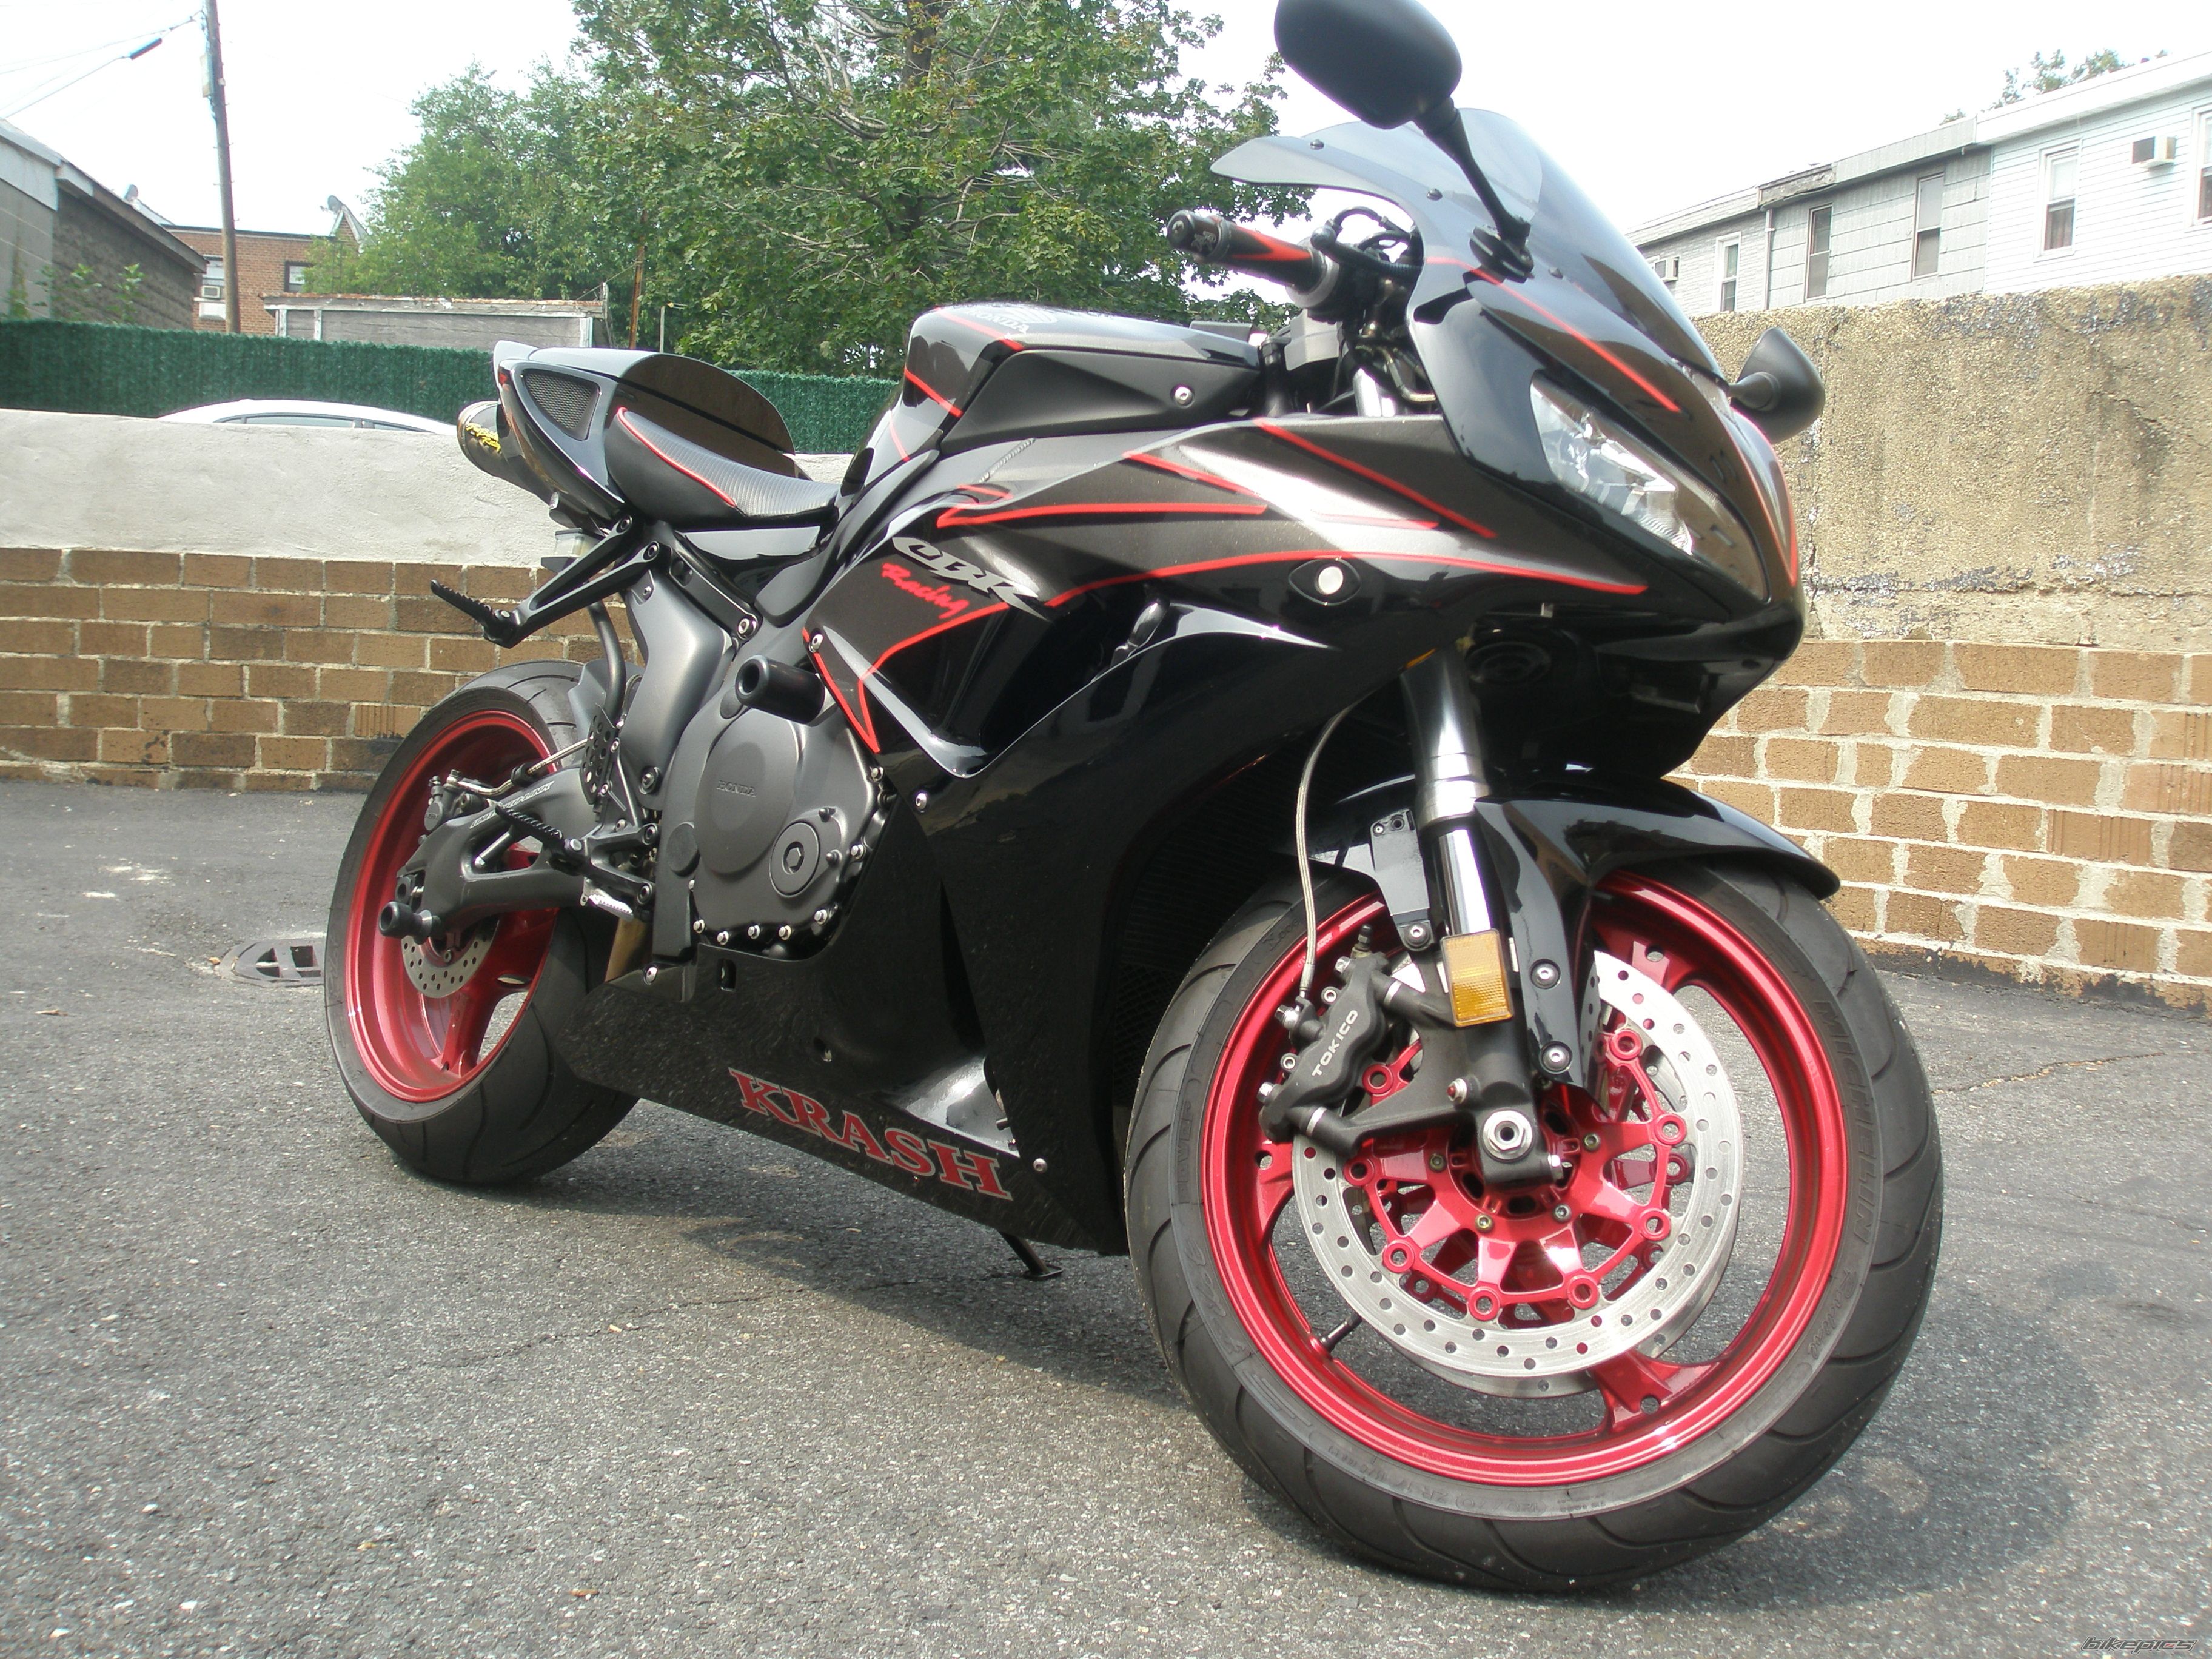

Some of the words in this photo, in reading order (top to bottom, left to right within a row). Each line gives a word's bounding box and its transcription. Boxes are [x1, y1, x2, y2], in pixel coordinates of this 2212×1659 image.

[892, 537, 1049, 622] CBR
[1312, 1010, 1359, 1077] TOKICO
[728, 1067, 1013, 1201] KRASH
[1814, 1000, 1877, 1244] MICHELIN
